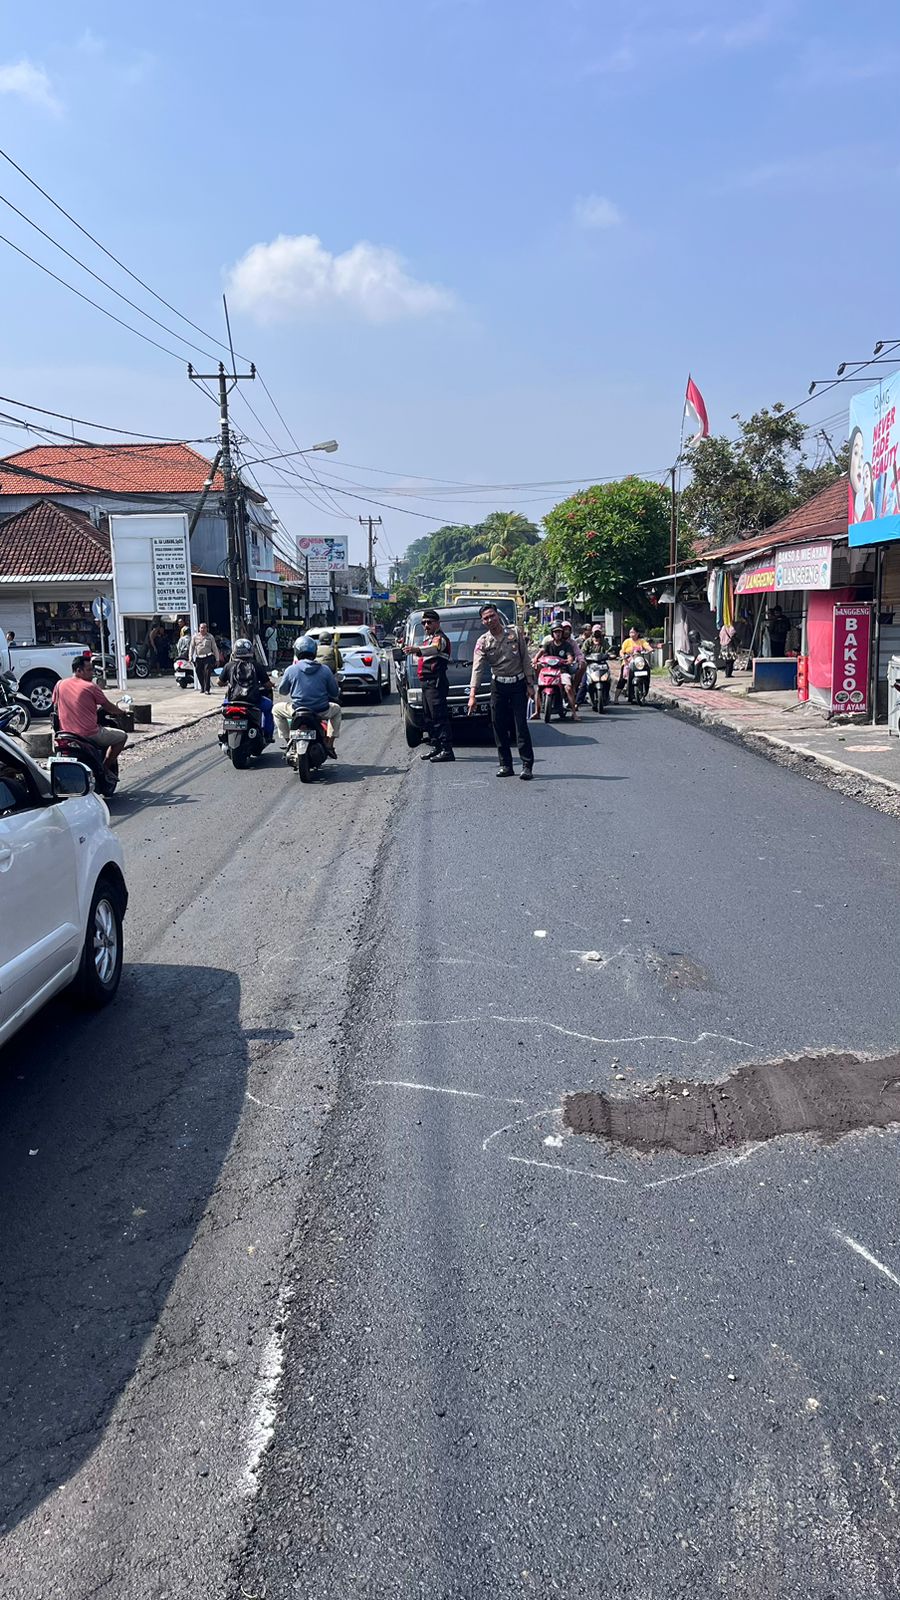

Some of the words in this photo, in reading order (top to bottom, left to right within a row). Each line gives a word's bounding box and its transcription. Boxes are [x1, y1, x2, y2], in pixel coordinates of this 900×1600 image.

[873, 405, 896, 445] NEVER
[871, 441, 899, 480] BEAUTY
[872, 431, 890, 464] FADE
[778, 549, 795, 564] BAKSO
[801, 547, 811, 561] MIE
[812, 545, 828, 560] AYAM
[783, 565, 819, 585] LANGGENG
[835, 607, 870, 616] LANGGENG
[843, 617, 858, 691] BAKSO
[832, 703, 846, 711] MIE
[846, 703, 866, 711] AYAM
